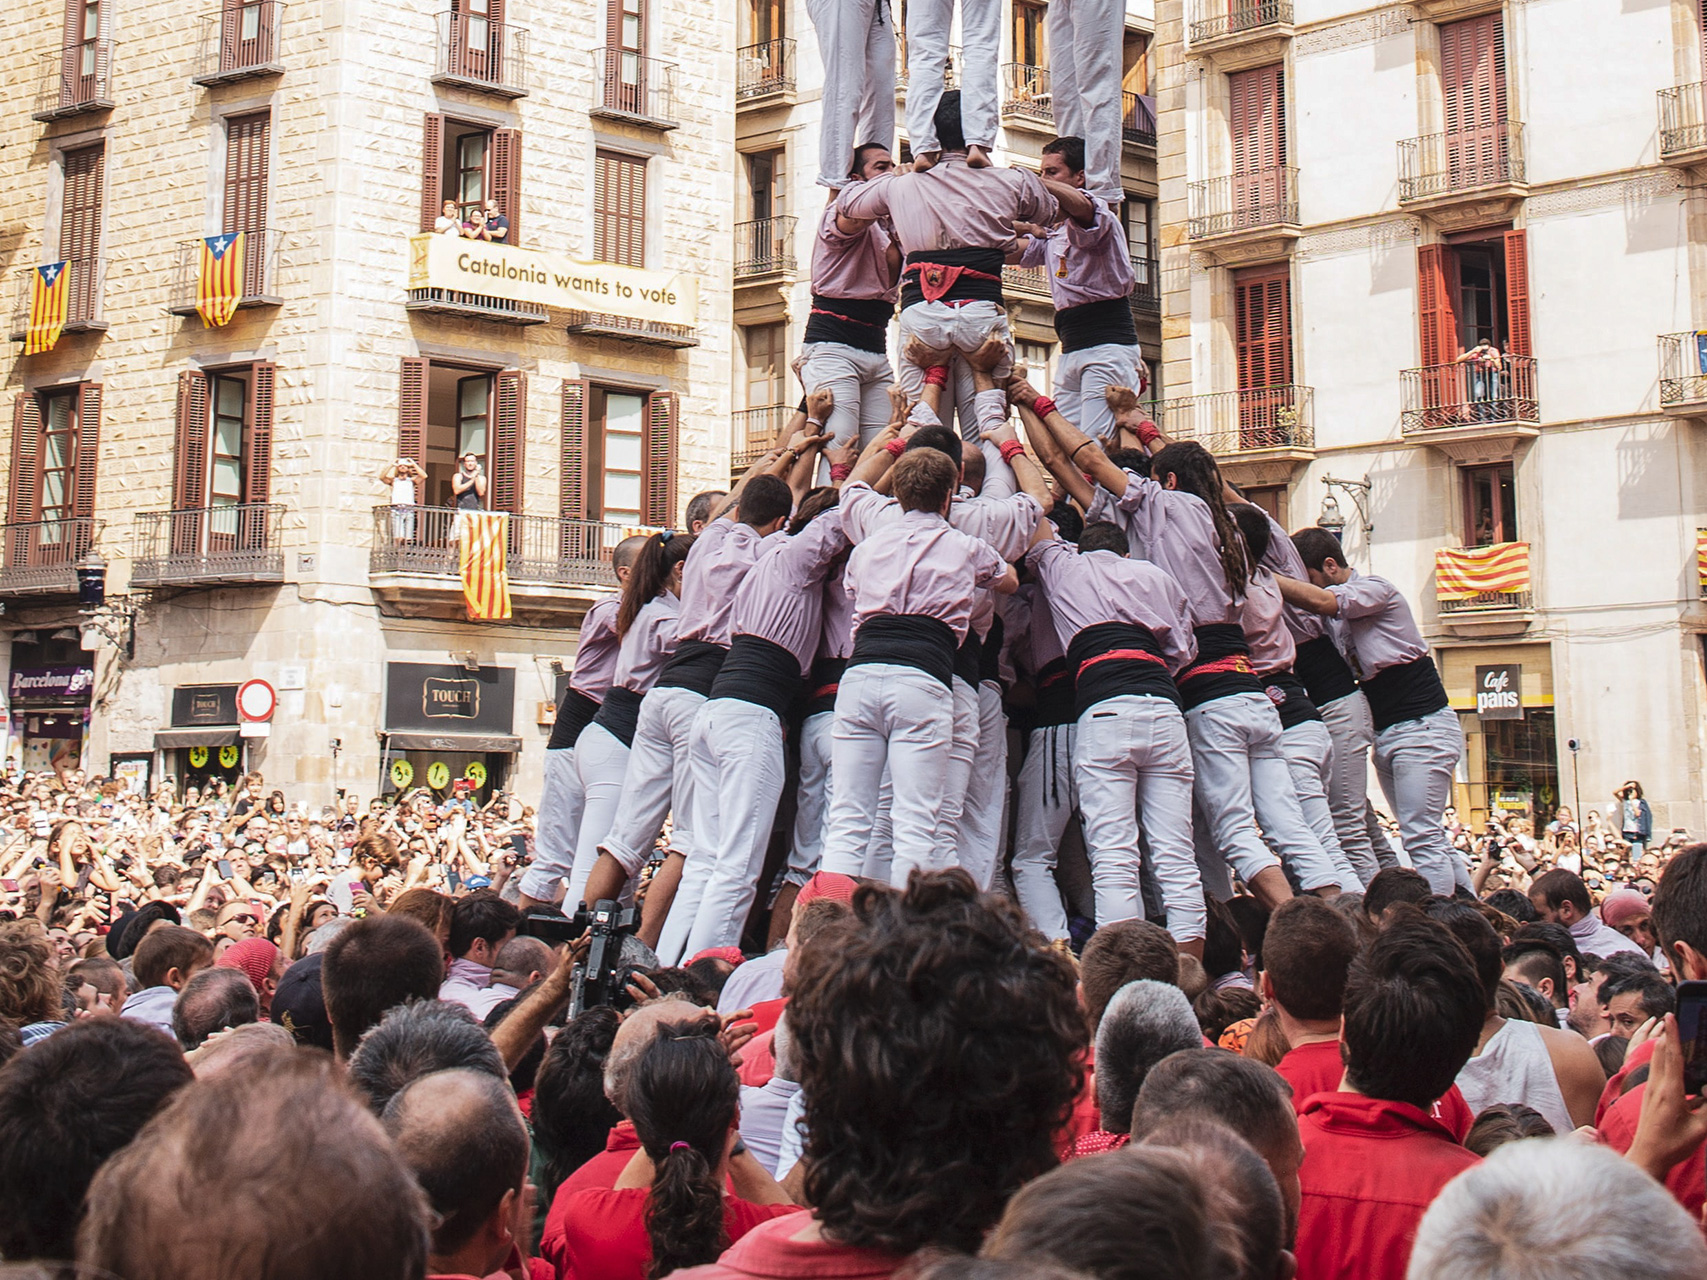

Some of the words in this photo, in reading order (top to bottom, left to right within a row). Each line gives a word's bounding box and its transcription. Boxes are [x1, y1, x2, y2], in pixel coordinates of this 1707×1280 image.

[458, 253, 547, 285] Catalonia
[554, 274, 609, 295] wants
[616, 281, 633, 298] to
[640, 288, 677, 305] vote
[12, 671, 70, 688] Barcelona
[432, 689, 471, 702] TOUCH
[1477, 691, 1519, 713] pans
